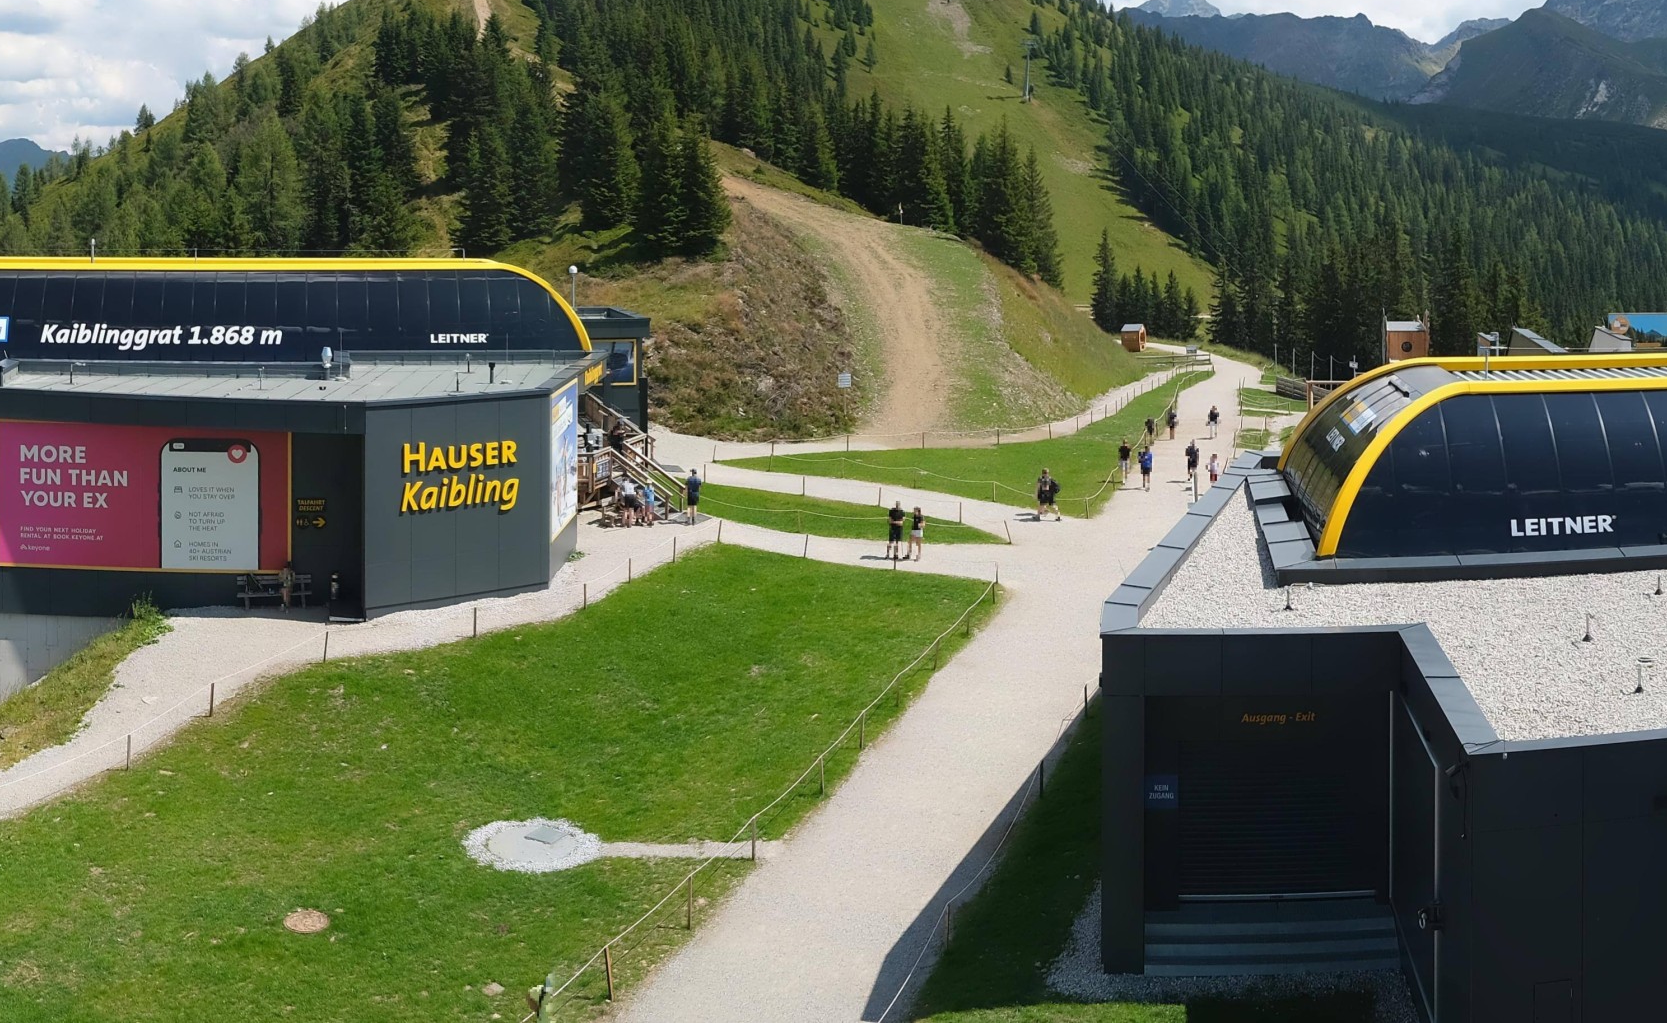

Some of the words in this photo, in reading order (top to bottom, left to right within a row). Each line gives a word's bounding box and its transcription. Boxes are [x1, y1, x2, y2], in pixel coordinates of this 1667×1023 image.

[40, 323, 182, 351] Kaiblinggrat
[187, 325, 254, 345] 1.868
[260, 330, 283, 345] m
[430, 333, 488, 344] LEITNER
[20, 445, 86, 464] MORE
[403, 440, 518, 474] HAUSER
[20, 468, 61, 485] FUN
[68, 469, 128, 487] THAN
[20, 490, 76, 507] YOUR
[83, 492, 108, 508] EX
[401, 473, 520, 512] Kaibling
[1510, 514, 1615, 537] LEITNER
[28, 544, 51, 552] keyone
[1241, 712, 1286, 725] Ausgang
[1295, 711, 1316, 722] Exit
[1149, 792, 1175, 800] ZUGANG
[1154, 784, 1169, 792] KEIN
